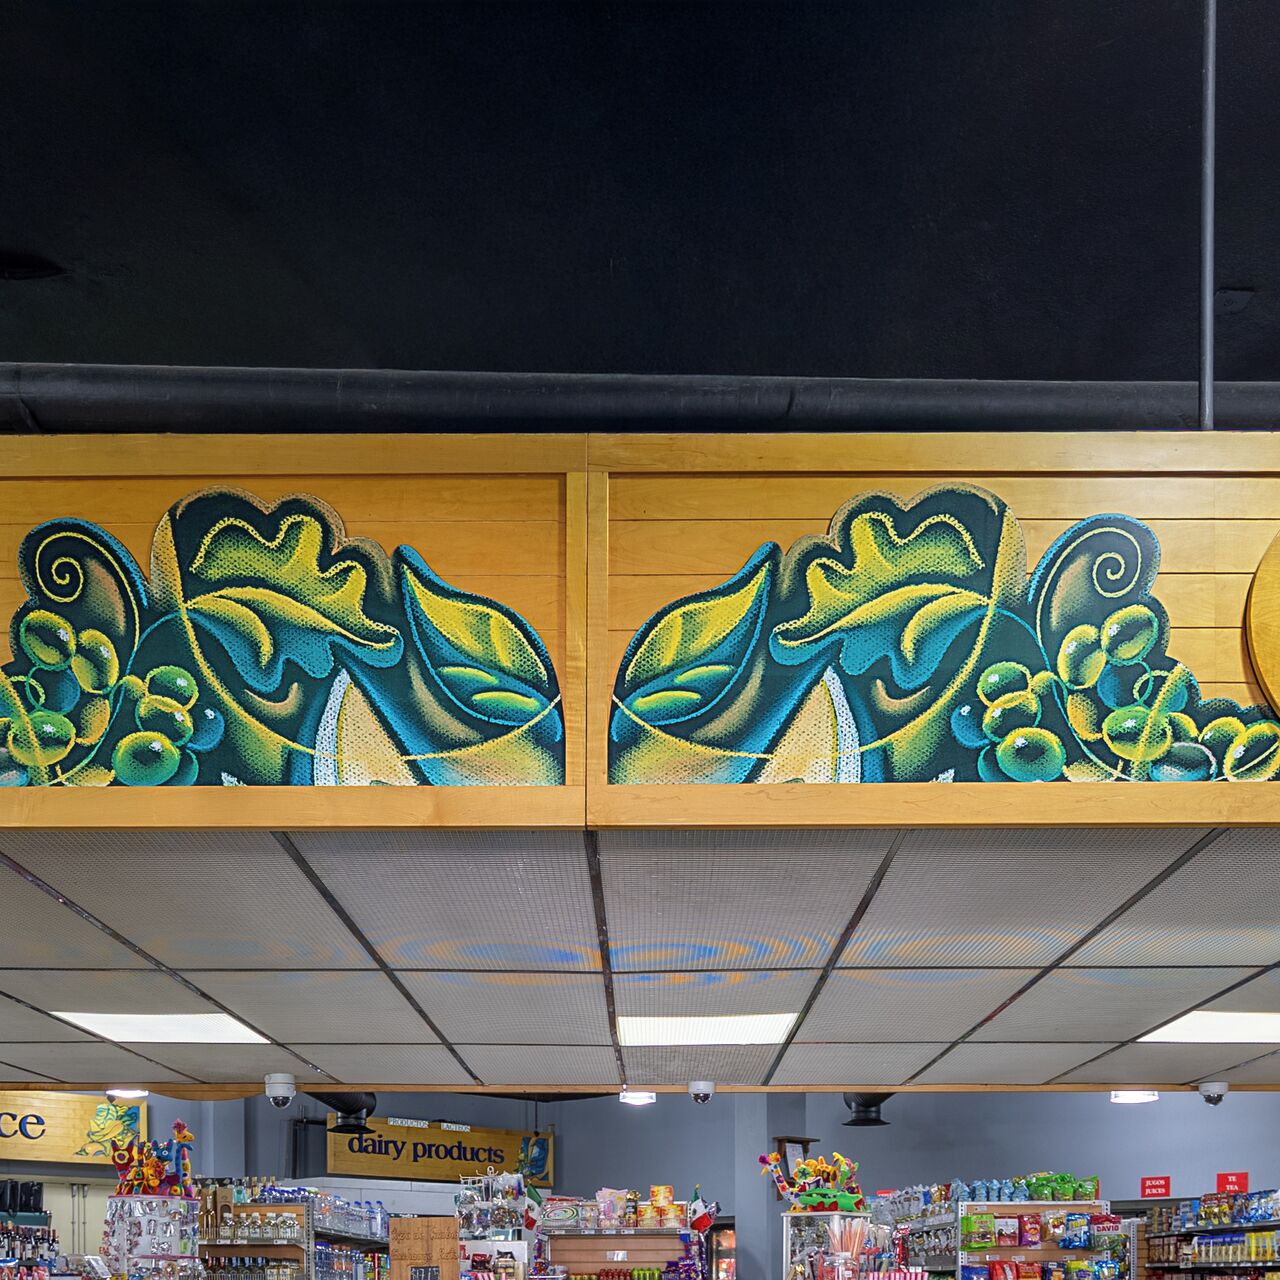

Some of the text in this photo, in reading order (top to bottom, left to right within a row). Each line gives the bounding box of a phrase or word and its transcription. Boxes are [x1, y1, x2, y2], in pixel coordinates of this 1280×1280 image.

[348, 1133, 505, 1164] dairy products
[1145, 1179, 1165, 1187] JUGOS
[1145, 1187, 1166, 1195] JUICES
[1096, 1224, 1120, 1232] DAVID
